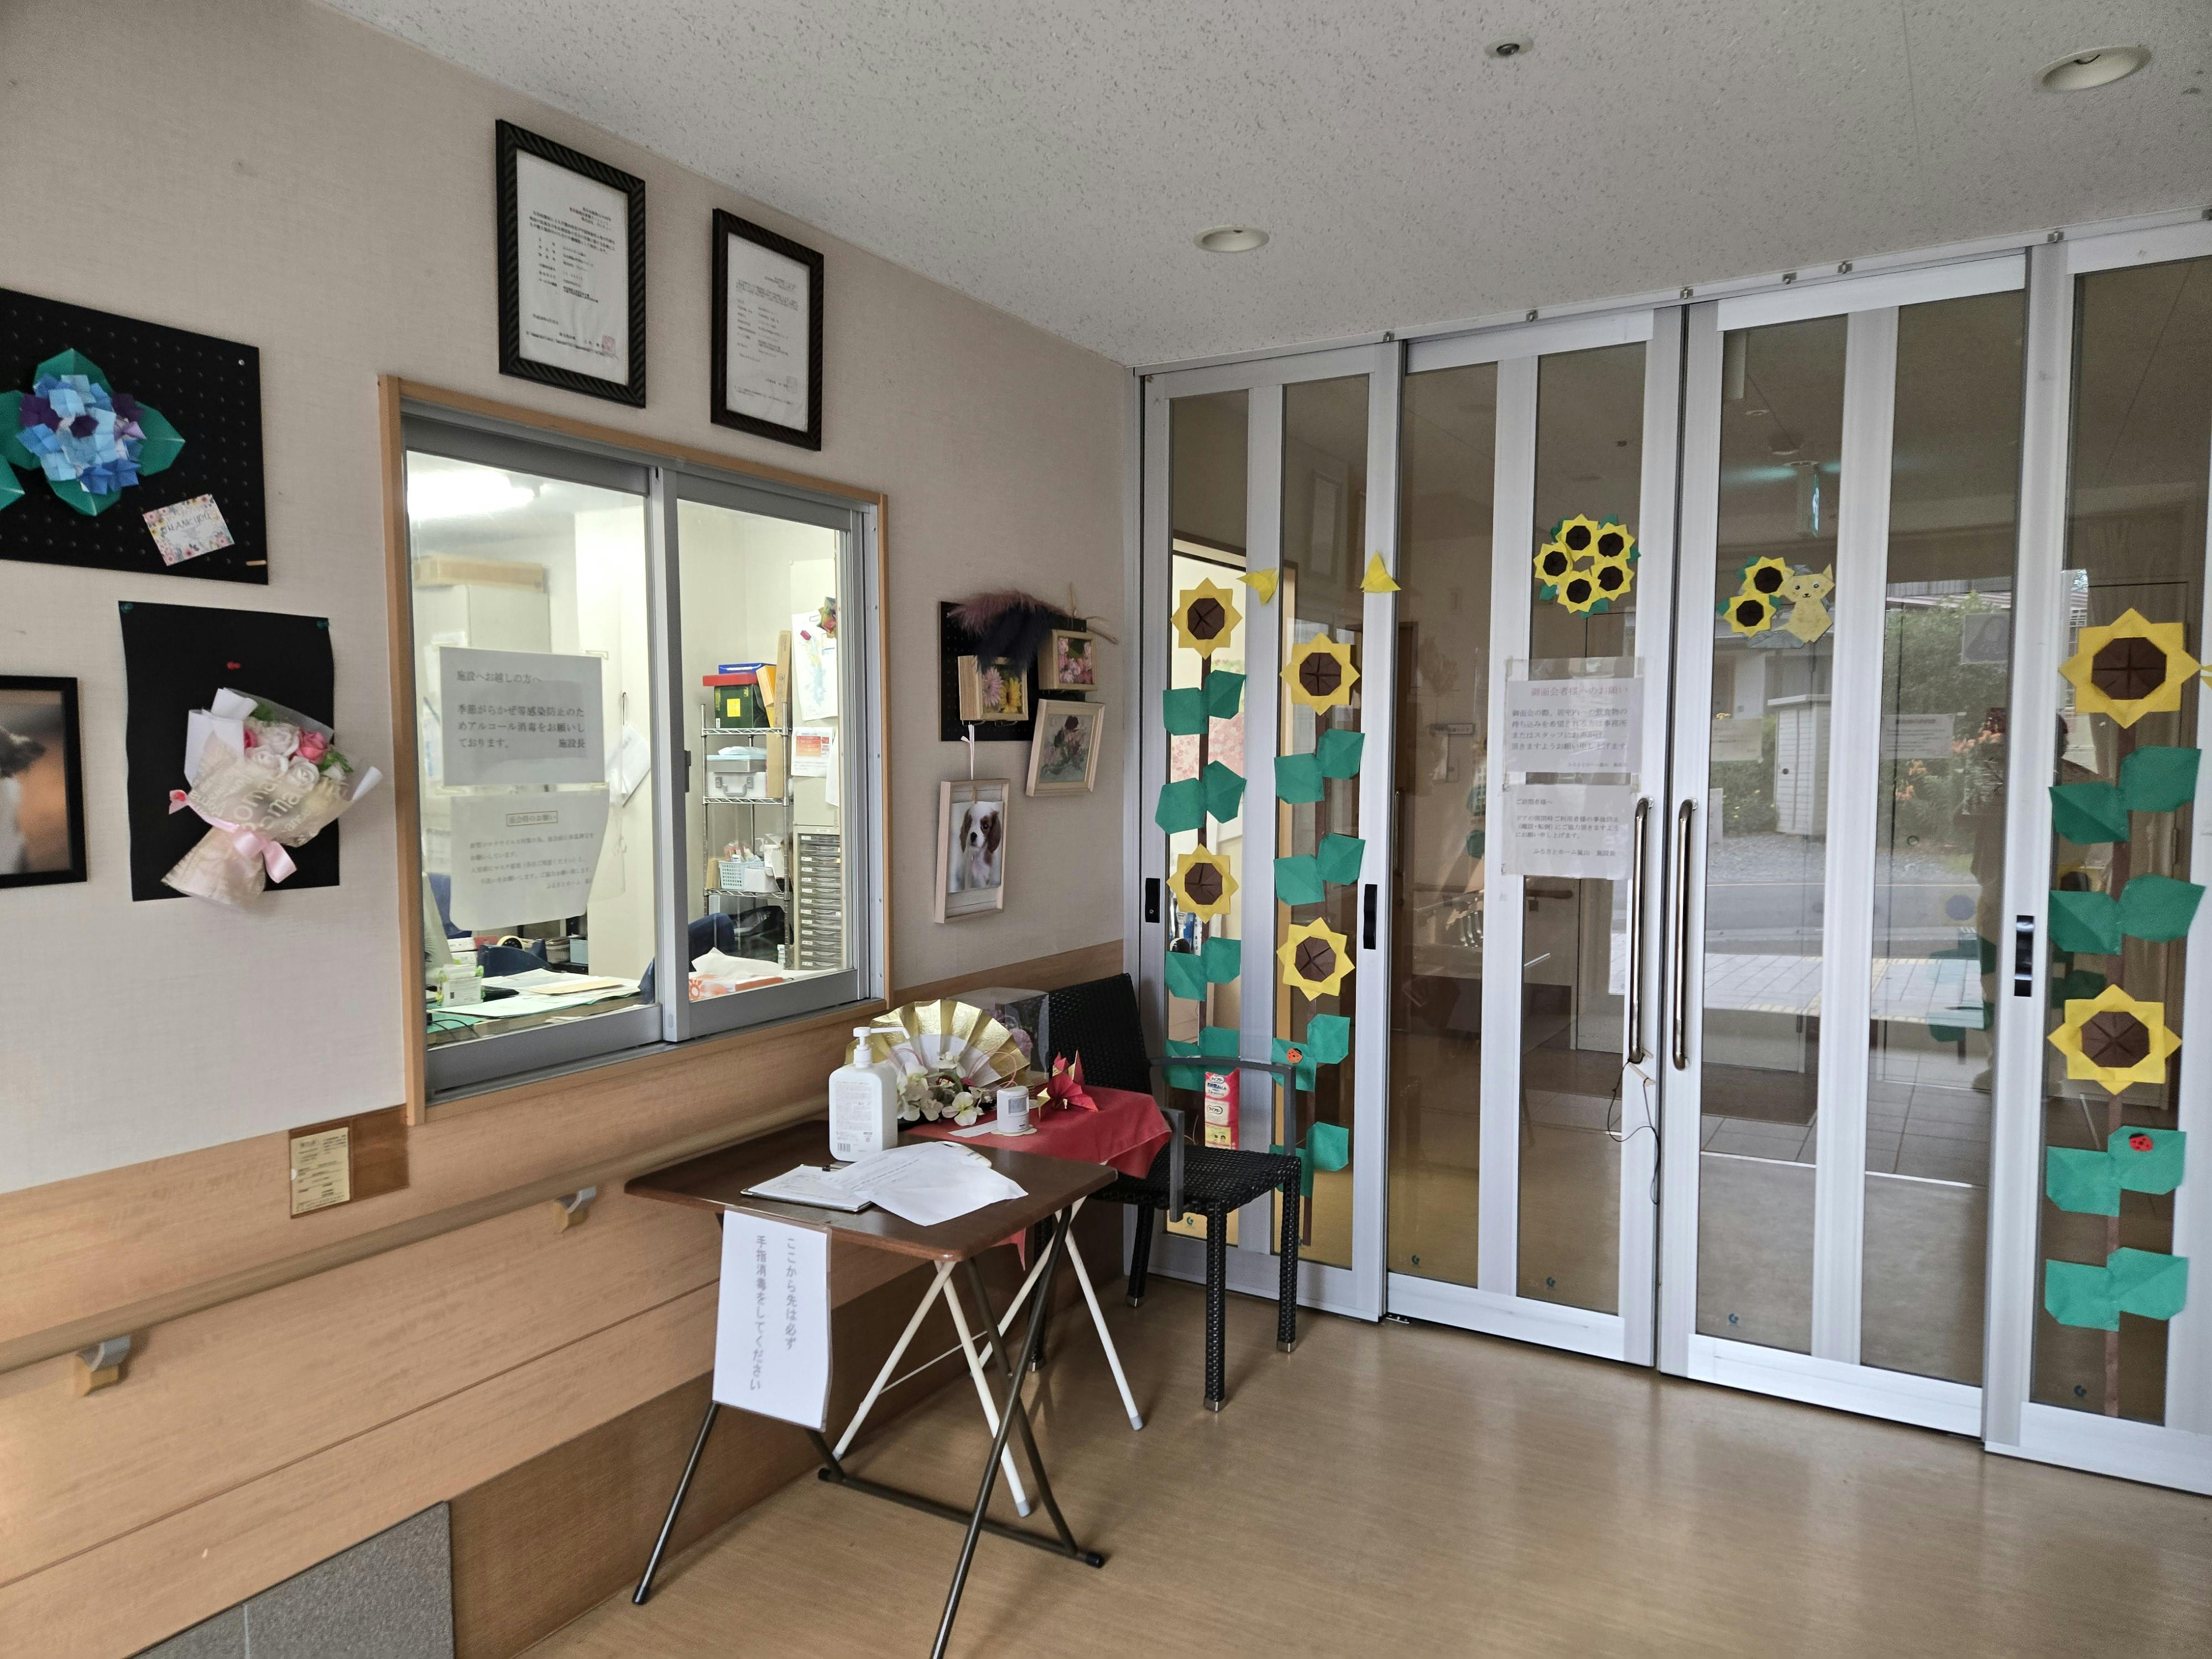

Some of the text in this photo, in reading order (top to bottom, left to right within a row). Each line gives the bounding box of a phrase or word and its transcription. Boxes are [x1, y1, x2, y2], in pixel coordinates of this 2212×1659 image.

[457, 671, 542, 684] 施設へお越しの方へ
[1531, 686, 1628, 697] 御面会者様へのお願い
[458, 703, 585, 717] 季節がらかぜ等感染防止のた
[458, 721, 585, 733] めアルコール消毒をお願いし
[458, 738, 586, 749] ております。 施設長
[785, 1238, 798, 1350] ここから先は必ず
[749, 1235, 767, 1391] 手指消毒をしてください
